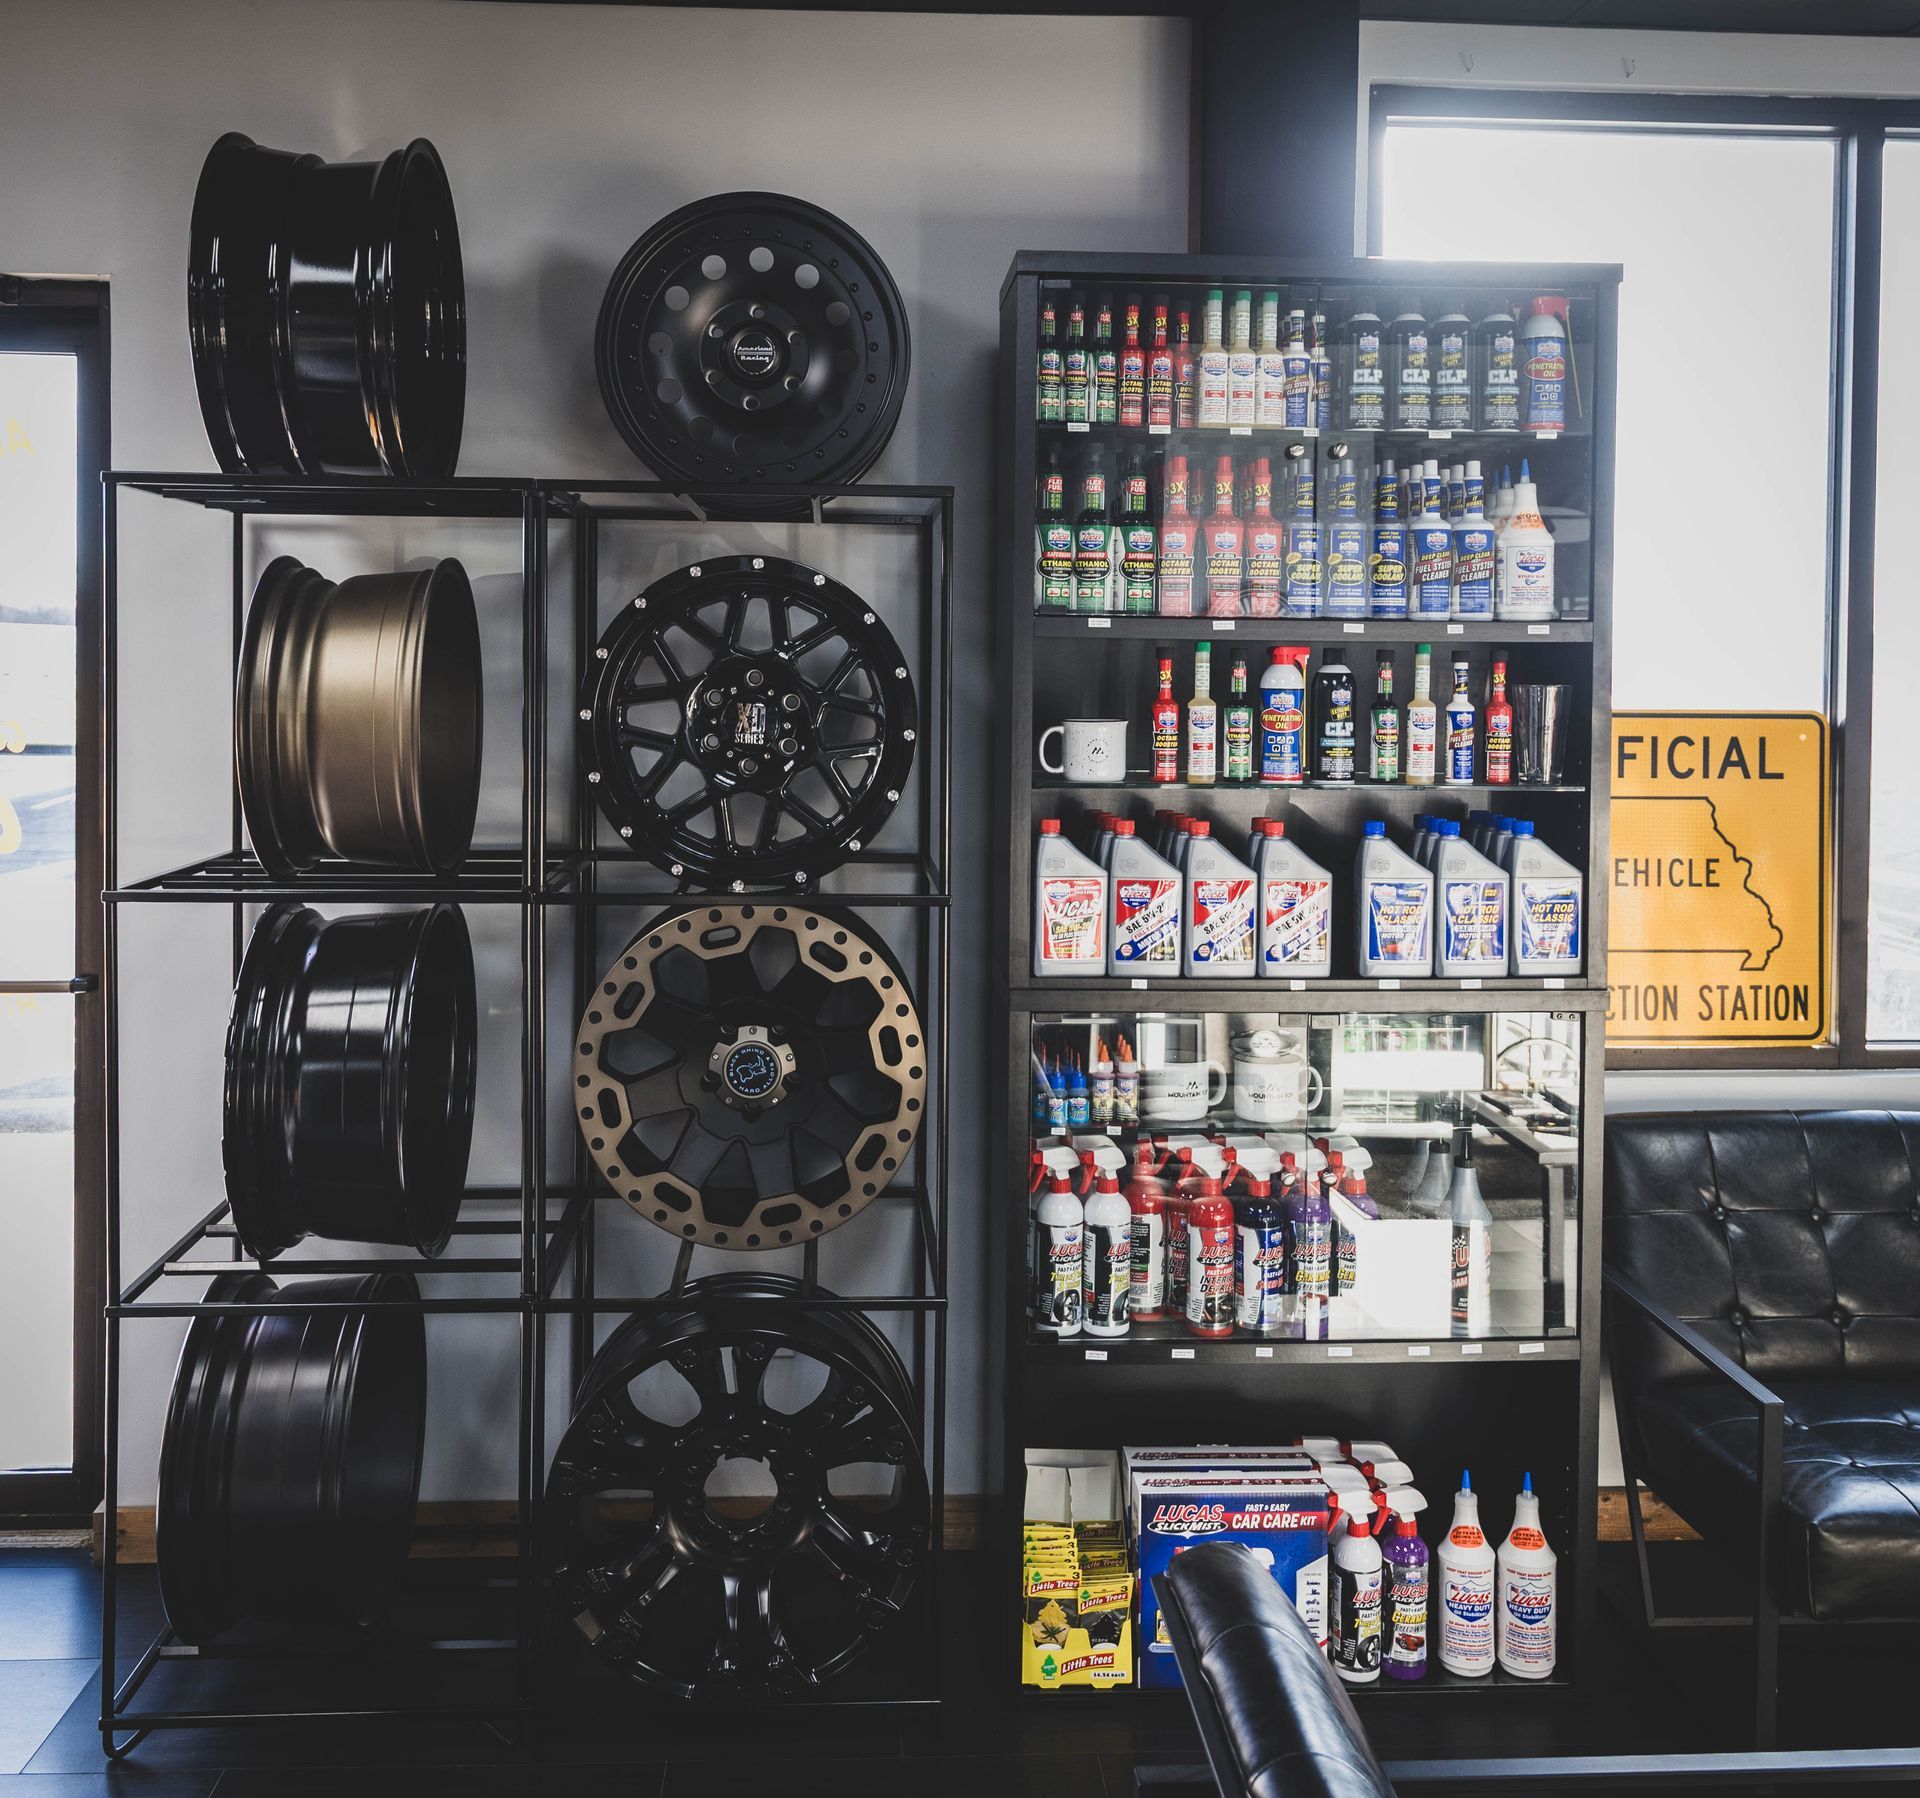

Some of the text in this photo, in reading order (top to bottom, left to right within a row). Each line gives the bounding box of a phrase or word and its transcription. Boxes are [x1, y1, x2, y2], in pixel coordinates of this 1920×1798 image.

[1127, 316, 1139, 327] 3X
[1156, 316, 1167, 327] 3X
[740, 355, 770, 363] Racing
[1353, 369, 1383, 384] CLP
[1402, 369, 1430, 384] CLP
[1437, 369, 1467, 384] CLP
[1488, 369, 1518, 384] CLP
[1170, 482, 1187, 495] 3X
[1216, 482, 1233, 496] 3X
[1255, 483, 1271, 497] 3X
[1421, 553, 1436, 561] DEEP
[1460, 554, 1475, 562] DEEP
[1159, 567, 1190, 575] BOOSTER
[1208, 567, 1240, 575] BOOSTER
[1297, 564, 1321, 572] SUPER
[1337, 564, 1363, 573] SUPER
[1378, 564, 1403, 573] SUPER
[1415, 564, 1431, 574] FUEL
[1456, 564, 1470, 574] FUEL
[1332, 572, 1364, 581] COOLANT
[1373, 572, 1404, 581] COOLANT
[1422, 571, 1449, 582] CLEANER
[1461, 571, 1490, 582] CLEANER
[1160, 670, 1172, 681] 3X
[1493, 673, 1505, 684] 3X
[736, 703, 766, 733] XD
[1262, 714, 1302, 722] PENETRATING
[1325, 721, 1354, 736] CLP
[735, 733, 765, 745] SERIES
[1616, 735, 1785, 780] FICIAL
[1613, 858, 1721, 888] EHICLE
[1380, 905, 1424, 915] HOT ROD
[1456, 905, 1500, 915] HOT ROD
[1531, 903, 1574, 913] HOT ROD
[1382, 914, 1424, 925] CLASSIC
[1457, 914, 1499, 924] CLASSIC
[1532, 913, 1574, 923] CLASSIC
[1126, 919, 1142, 934] SAE
[1698, 984, 1810, 1022] STATION
[729, 1054, 740, 1077] BLACK
[1245, 1503, 1263, 1512] FAST
[1270, 1503, 1290, 1512] EASY
[1152, 1504, 1225, 1523] LUCAS
[1232, 1512, 1317, 1529] CAR CARE KIT
[1072, 1571, 1080, 1580] 3
[1031, 1579, 1078, 1593] Little Trees
[1081, 1593, 1127, 1610] Little Trees
[1451, 1591, 1491, 1604] LUCAS
[1511, 1594, 1551, 1607] LUCAS
[1448, 1601, 1491, 1612] HEAVY DUTY
[1508, 1603, 1550, 1614] HEAVY DUTY
[1062, 1655, 1113, 1674] Little Trees
